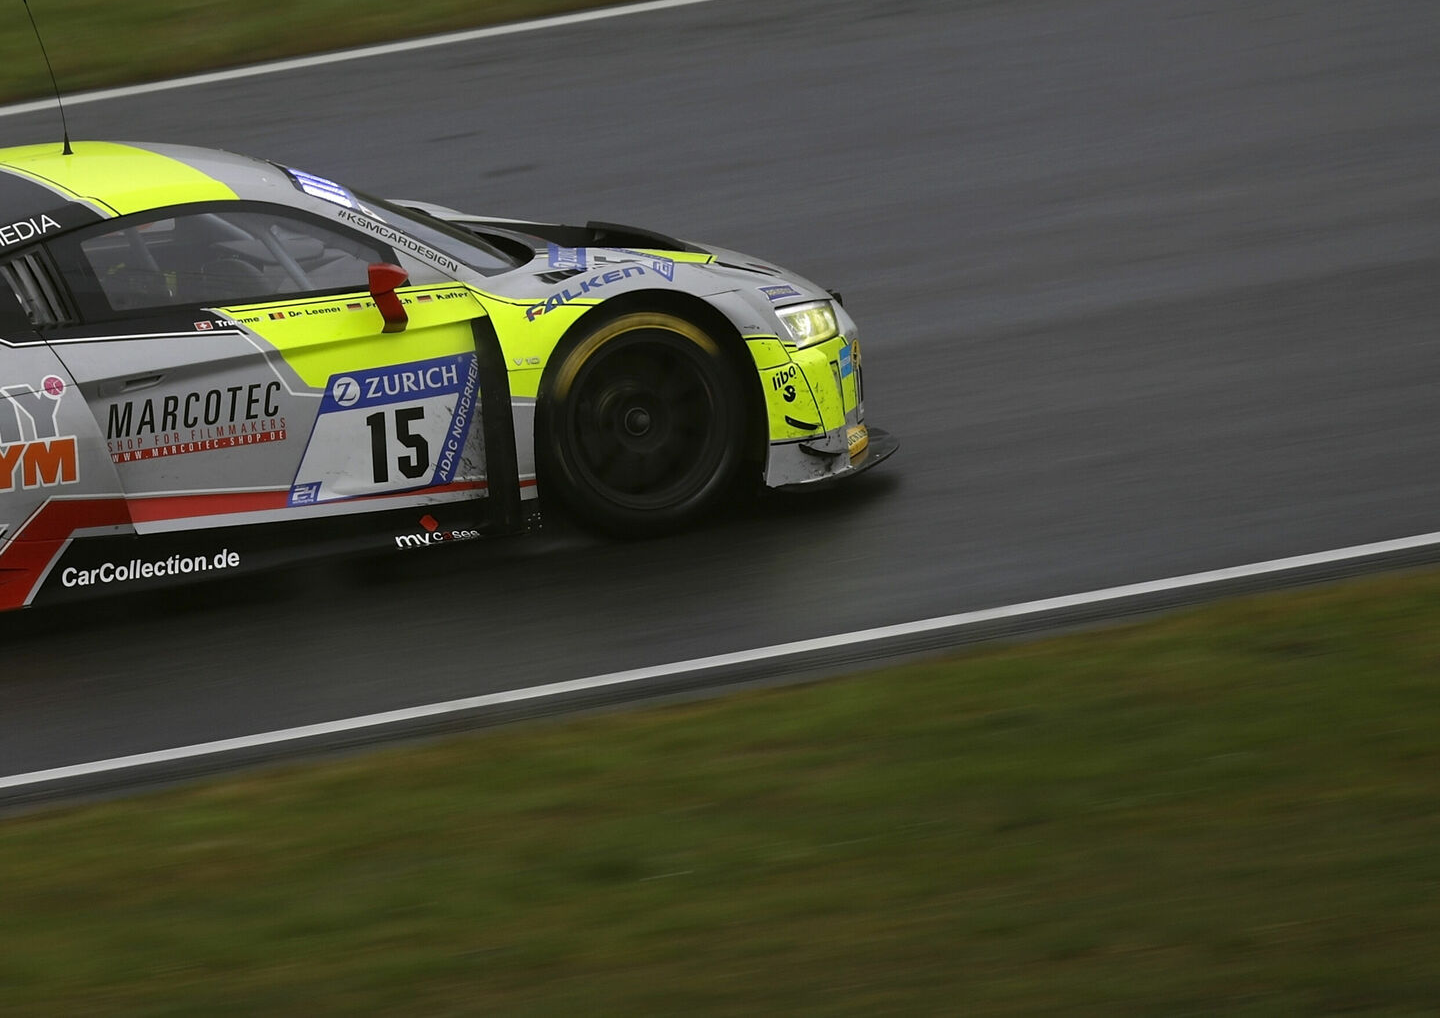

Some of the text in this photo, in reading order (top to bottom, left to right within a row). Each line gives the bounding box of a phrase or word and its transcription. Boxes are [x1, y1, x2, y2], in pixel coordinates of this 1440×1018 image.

[338, 210, 458, 273] #KSMCARDESIGN
[526, 266, 646, 322] FALKEN
[367, 364, 459, 399] ZURICH
[107, 381, 281, 440] MARCOTEC
[107, 417, 286, 452] SHOP FOR FILMMAKERS
[439, 354, 479, 482] ADAC NORDRHEIN
[111, 430, 285, 463] WWW.MARCOTEC-SHOP.DE
[366, 406, 430, 484] 15
[62, 549, 240, 588] CarCollection.de
